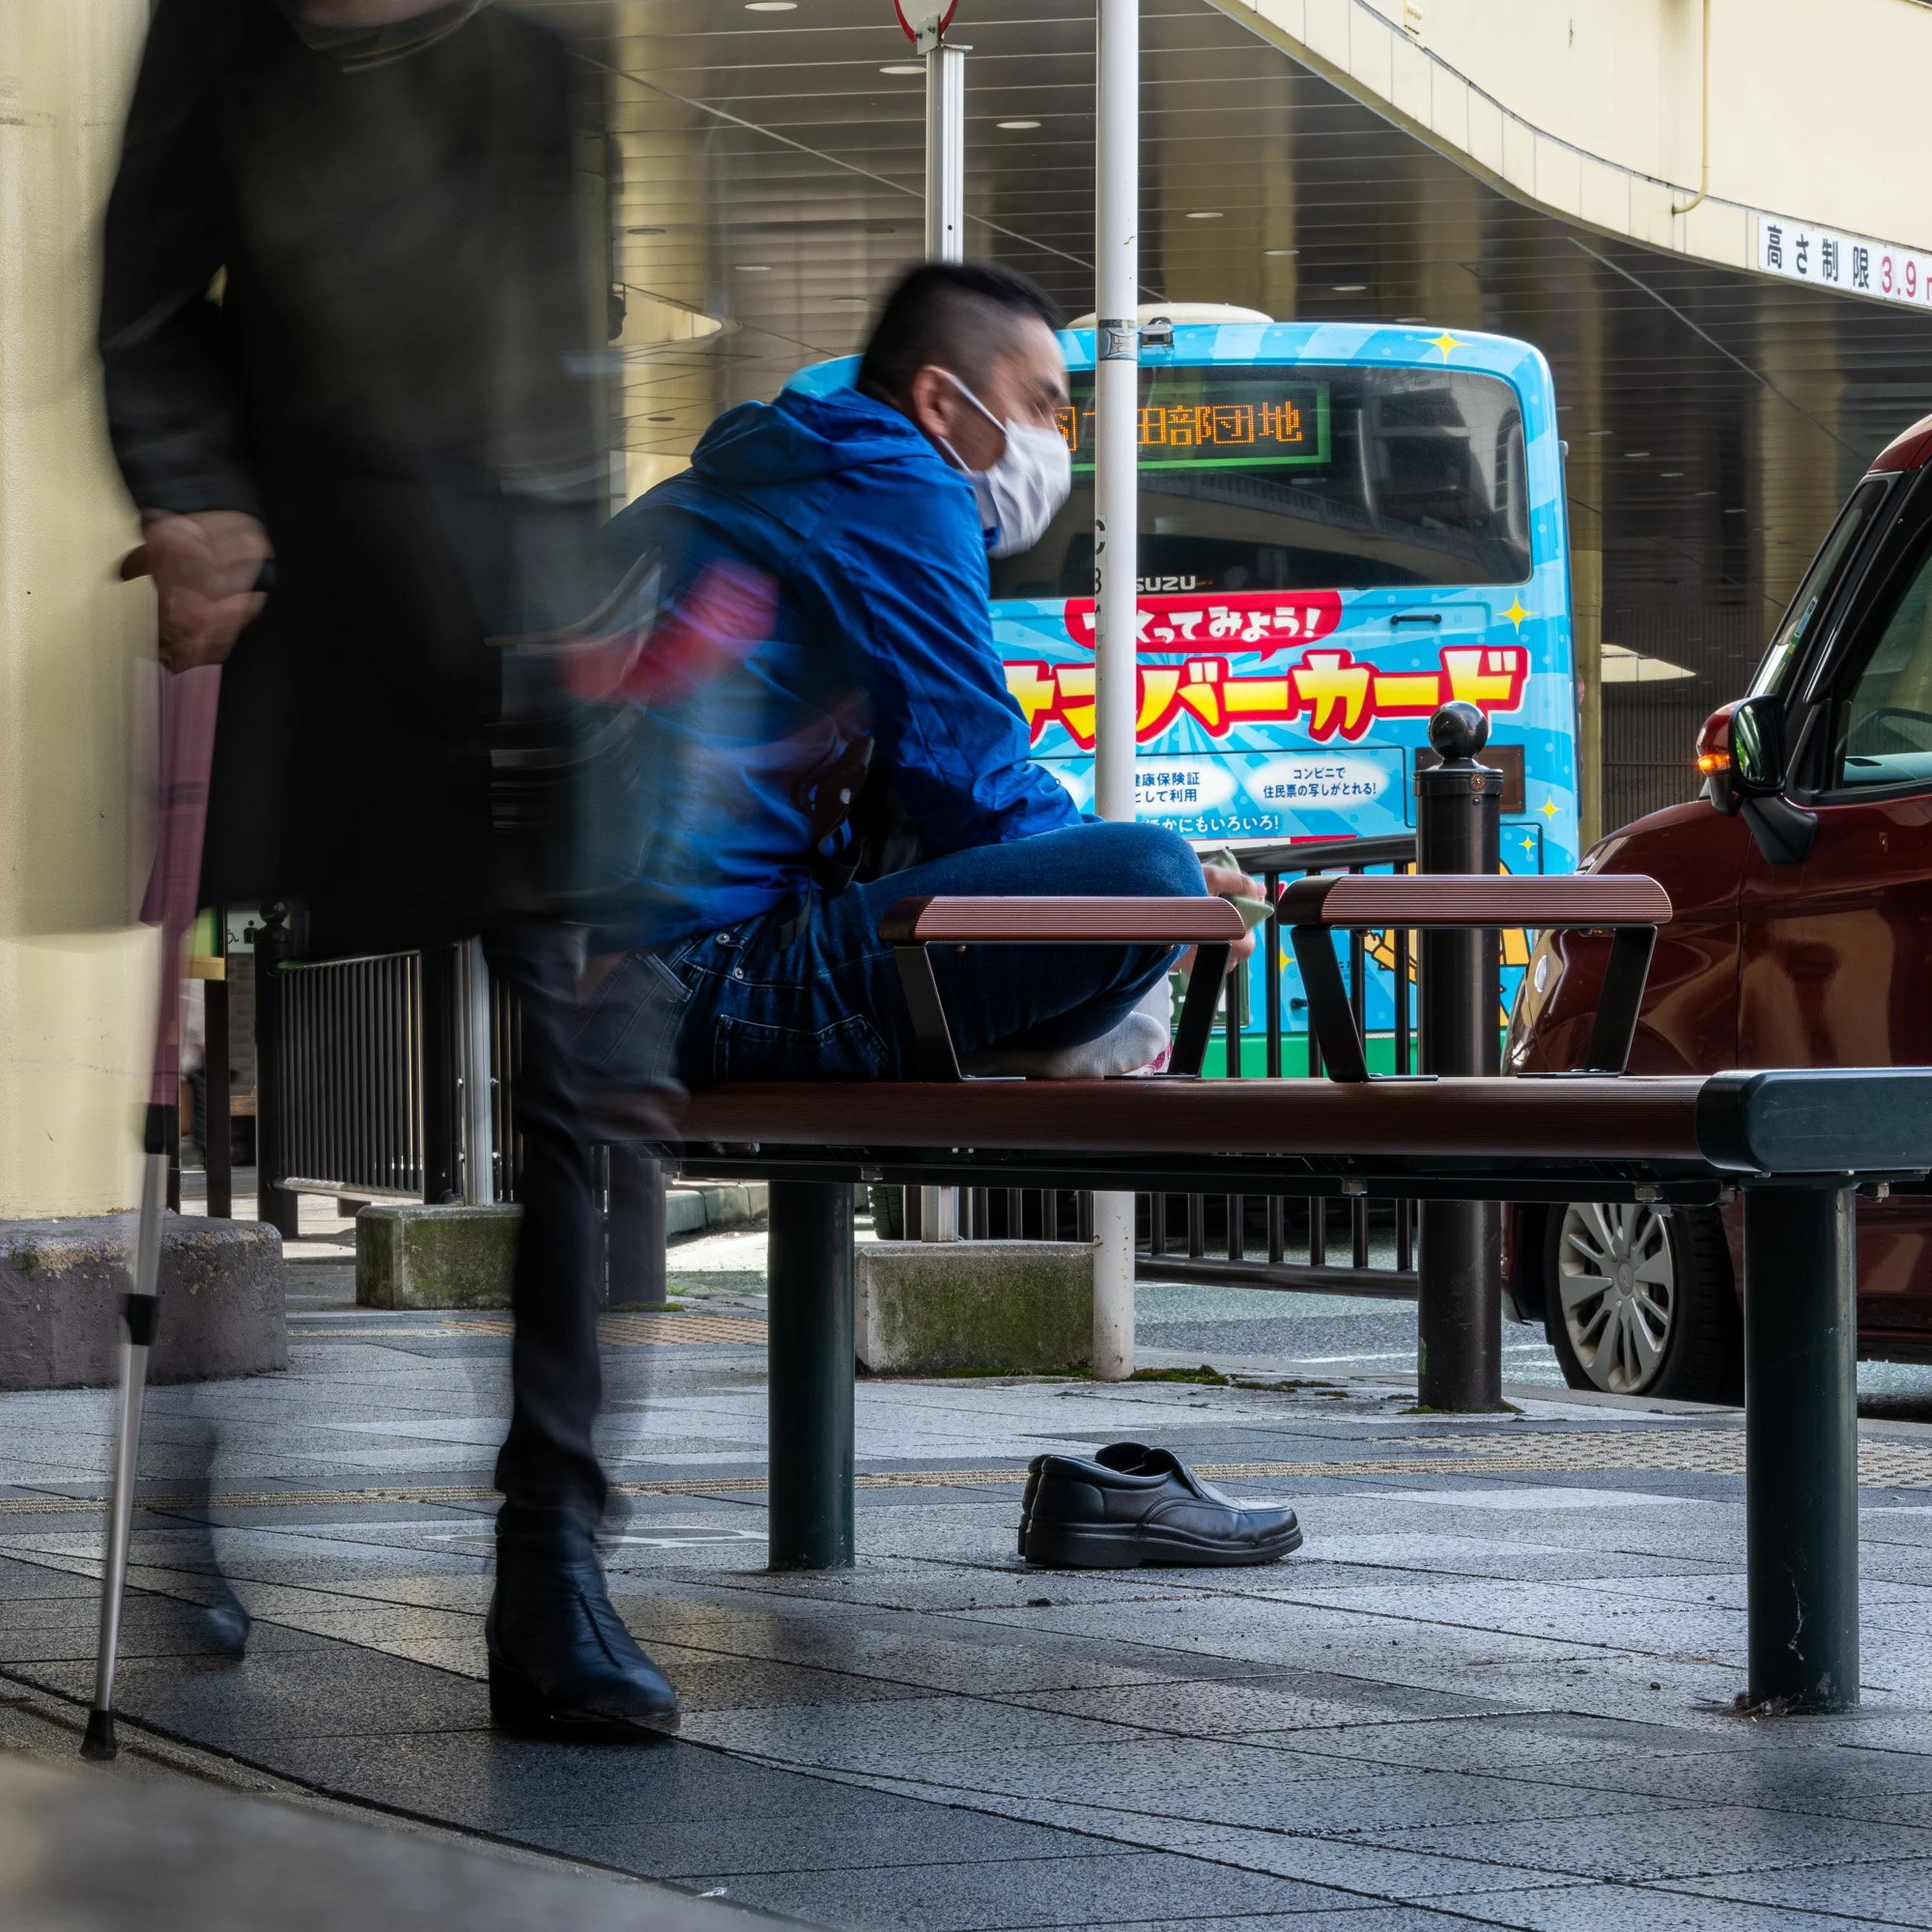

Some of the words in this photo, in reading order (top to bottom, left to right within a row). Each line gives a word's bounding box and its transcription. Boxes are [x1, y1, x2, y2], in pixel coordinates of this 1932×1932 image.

[1136, 576, 1196, 592] SUZU
[1293, 767, 1347, 780] コンビニで
[1263, 782, 1377, 799] 住民票の写しがとれる!
